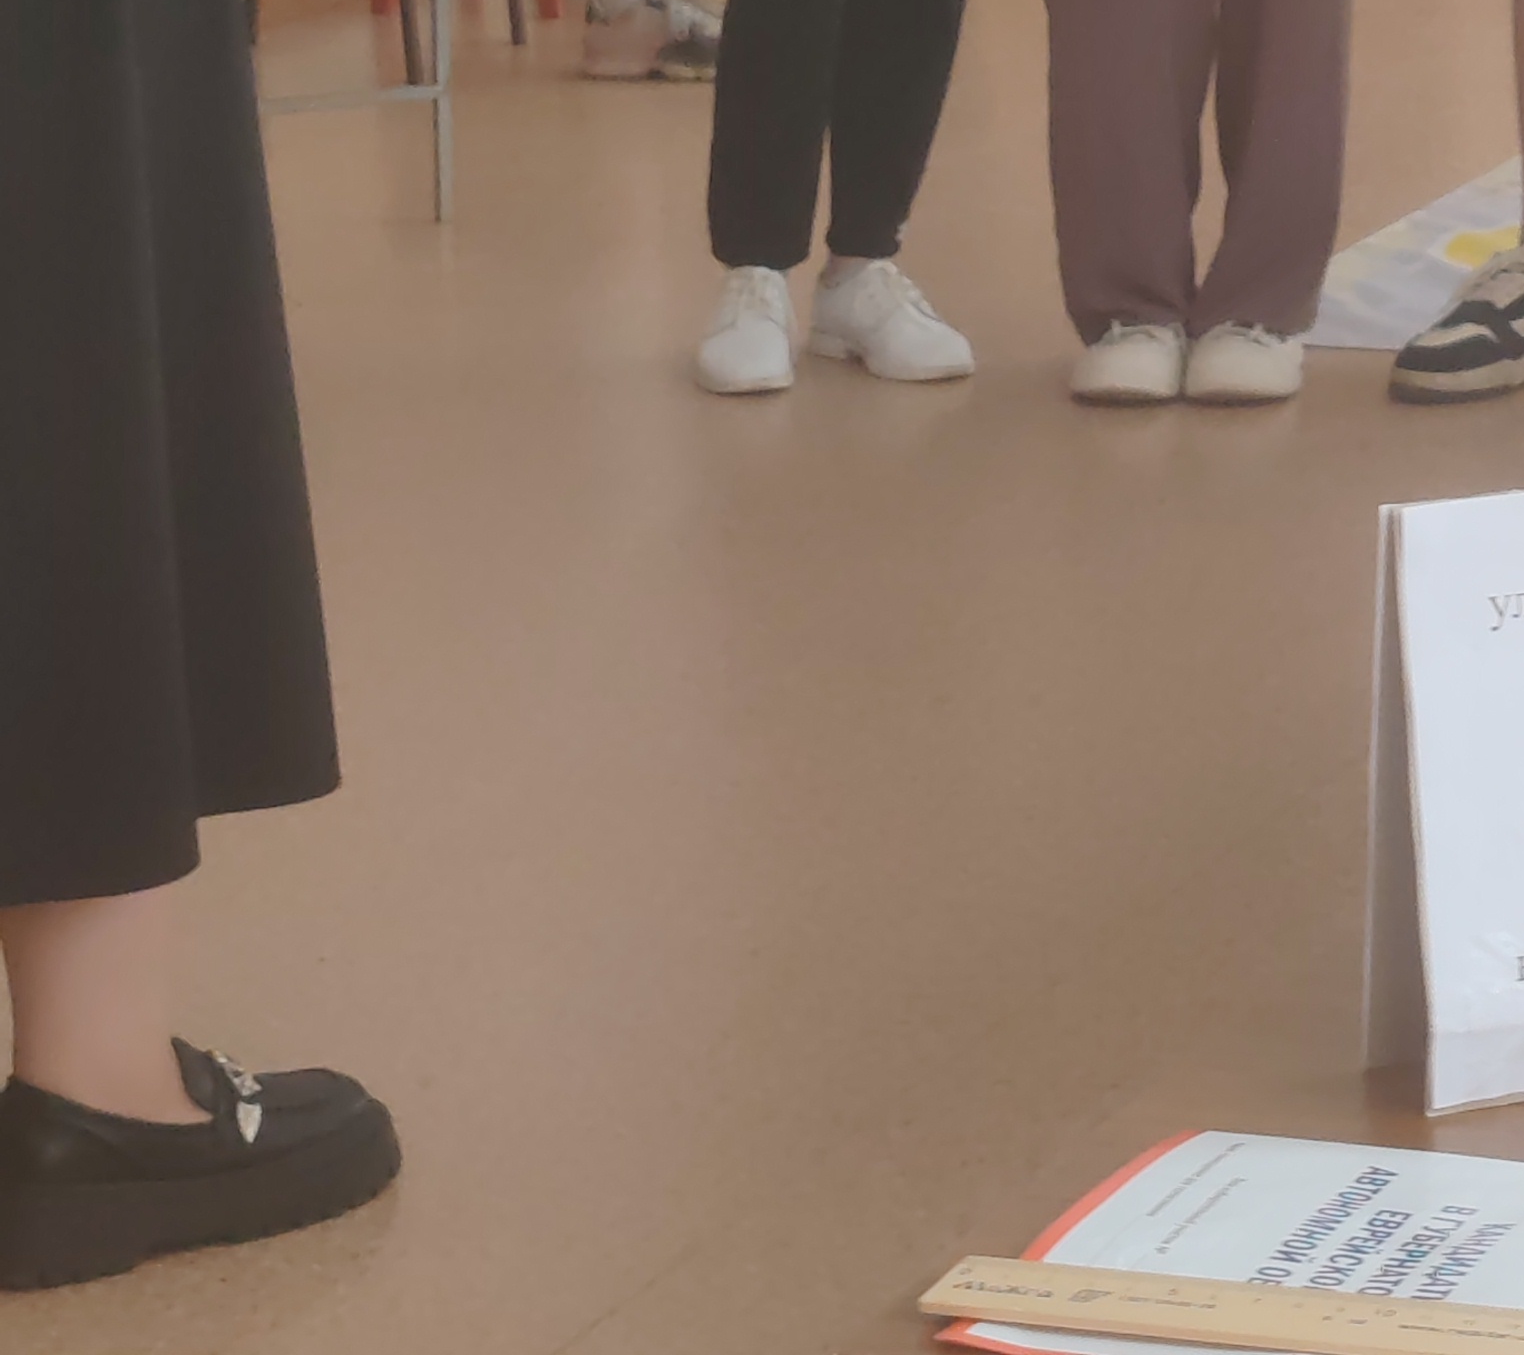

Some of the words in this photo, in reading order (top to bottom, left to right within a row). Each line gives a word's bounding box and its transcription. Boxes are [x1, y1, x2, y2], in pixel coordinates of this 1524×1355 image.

[1268, 1165, 1400, 1265] АВТОНОМНОЙ
[1303, 1209, 1414, 1290] ЕВРЕЙСКО
[1357, 1216, 1467, 1296] ГУБЕРНАТО
